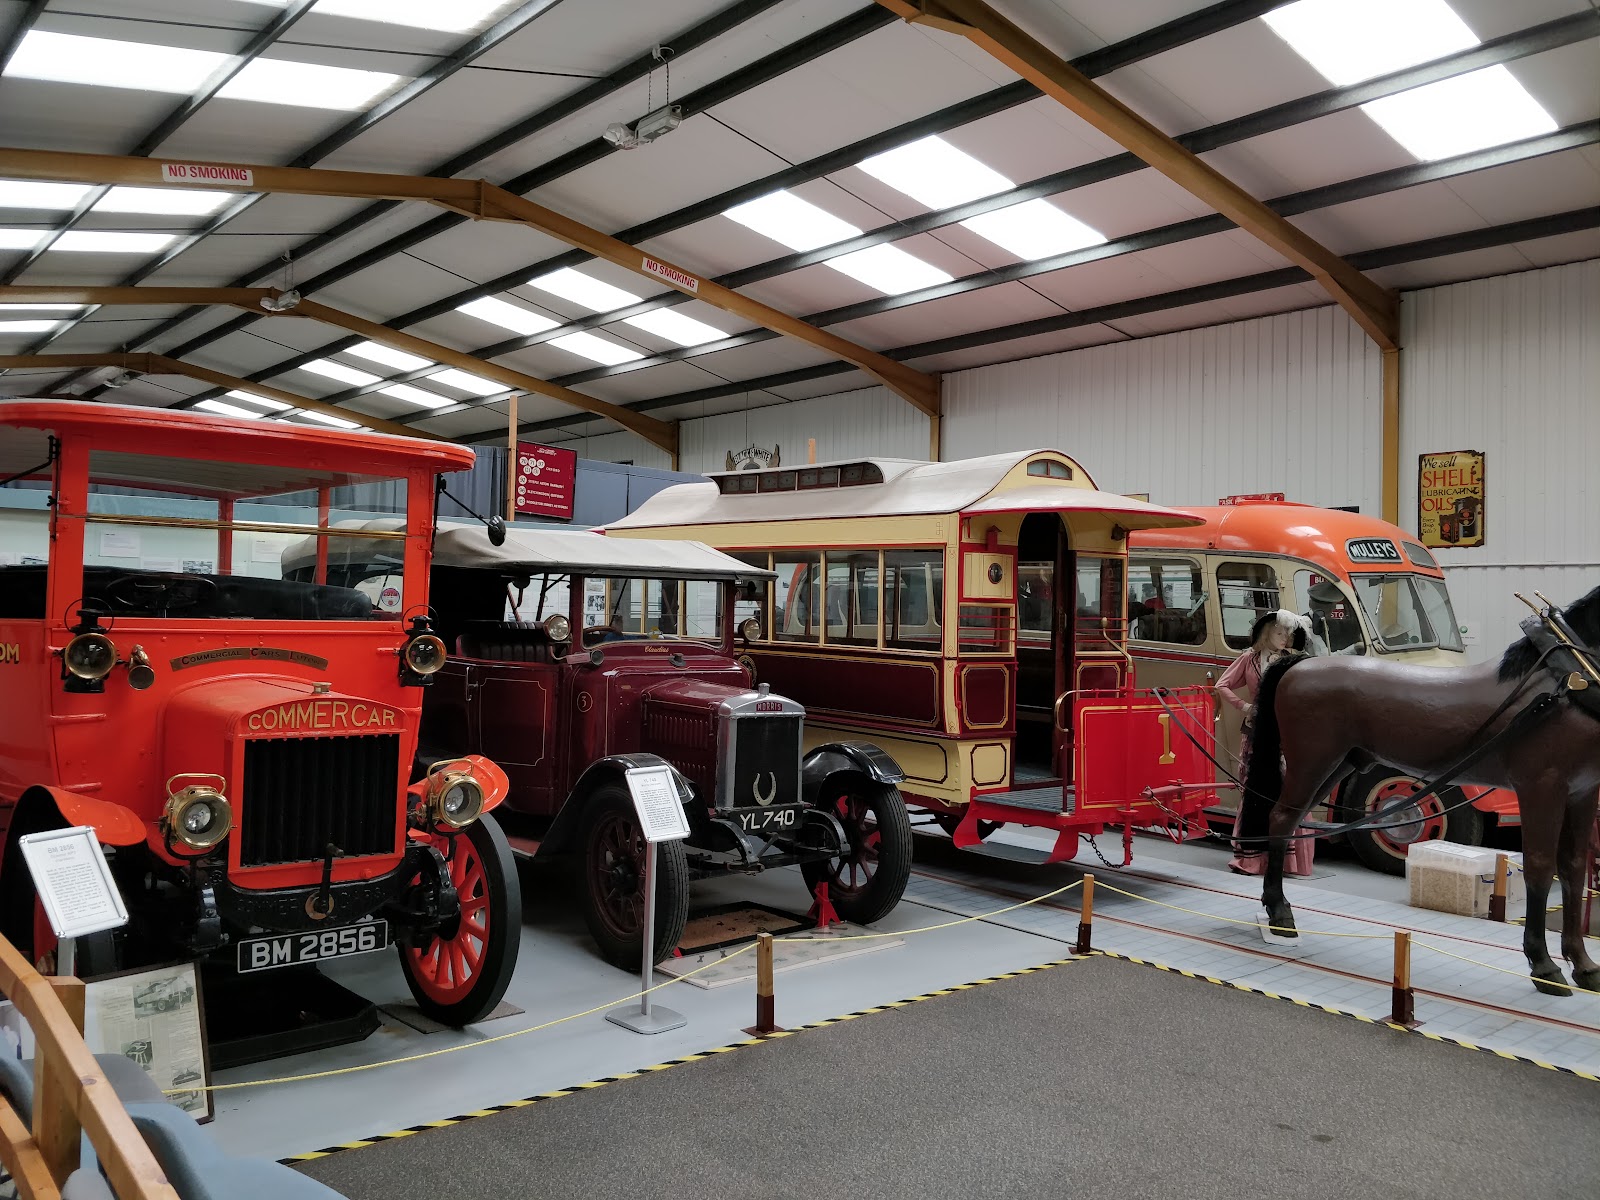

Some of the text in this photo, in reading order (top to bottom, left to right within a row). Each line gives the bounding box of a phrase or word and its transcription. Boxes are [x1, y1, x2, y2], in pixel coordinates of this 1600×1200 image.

[168, 164, 248, 181] NO SMOKING
[646, 259, 695, 289] NO SMOKING
[1422, 455, 1458, 469] We sell
[1422, 467, 1480, 489] SHELL
[1422, 487, 1480, 497] LUBRICATING
[1421, 497, 1454, 512] OILS
[1350, 542, 1397, 558] MULLEYS
[581, 695, 587, 708] 3
[757, 702, 782, 711] MORRIS
[248, 701, 395, 730] COMMERCAR
[1158, 714, 1176, 765] 1
[251, 926, 376, 968] BM 2856
